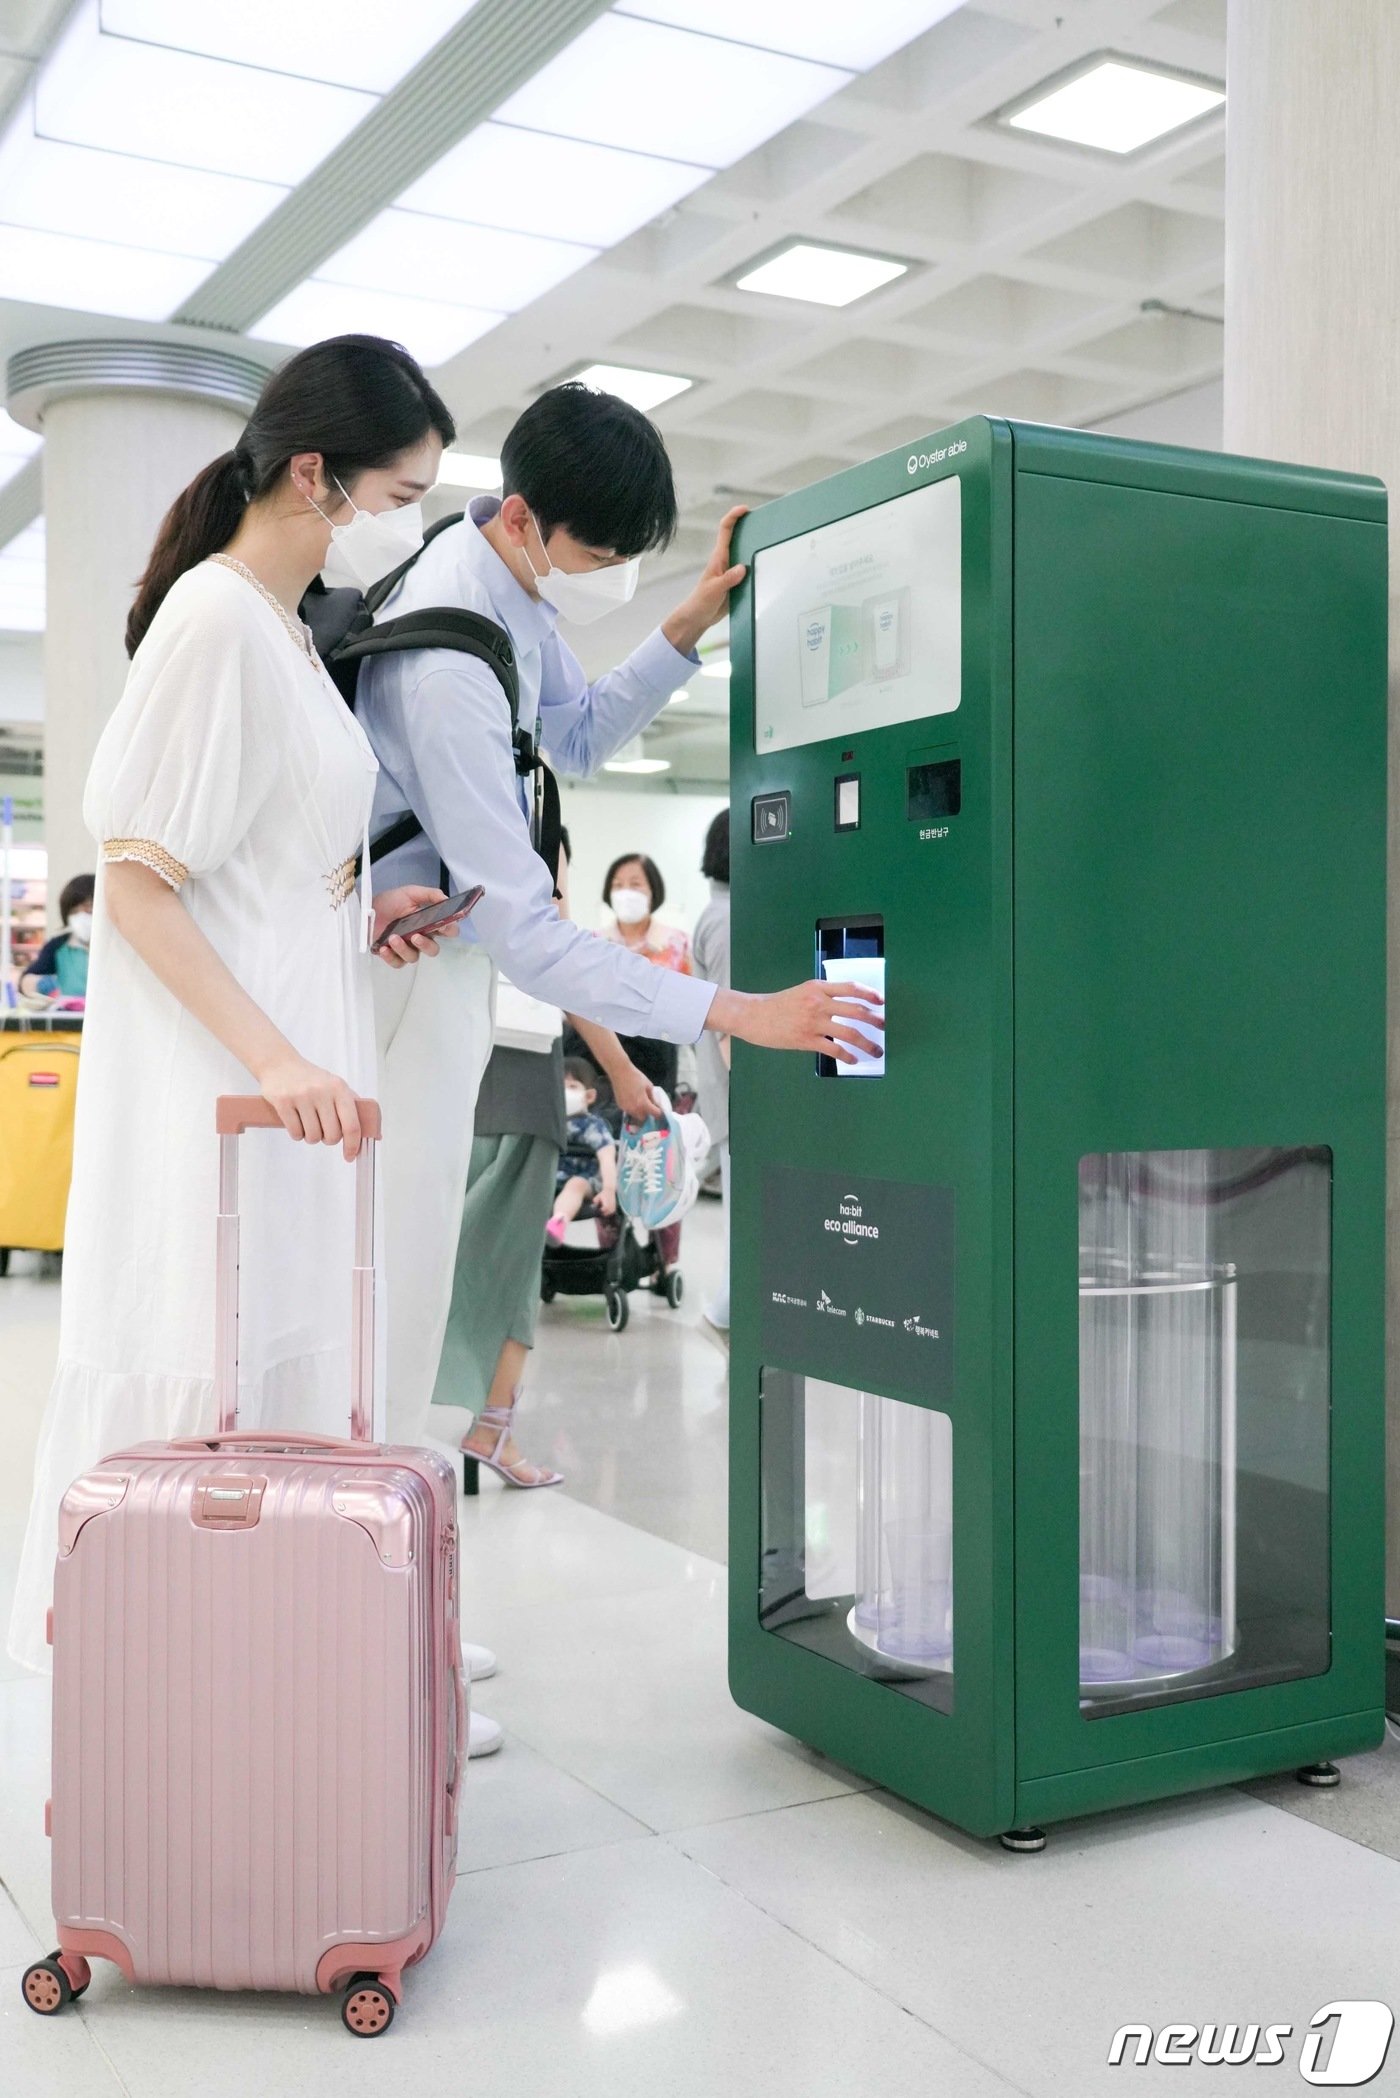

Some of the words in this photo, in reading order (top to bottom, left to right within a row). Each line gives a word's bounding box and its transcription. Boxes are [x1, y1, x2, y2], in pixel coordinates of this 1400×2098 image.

[918, 447, 948, 469] Oyster
[948, 440, 967, 457] able
[919, 826, 949, 840] 현금반납구
[839, 1203, 862, 1218] ha:bit
[824, 1218, 841, 1231] eco
[842, 1219, 879, 1239] alliance
[816, 1300, 826, 1312] SK
[826, 1305, 847, 1317] telecom
[866, 1315, 895, 1328] STARBUCKS
